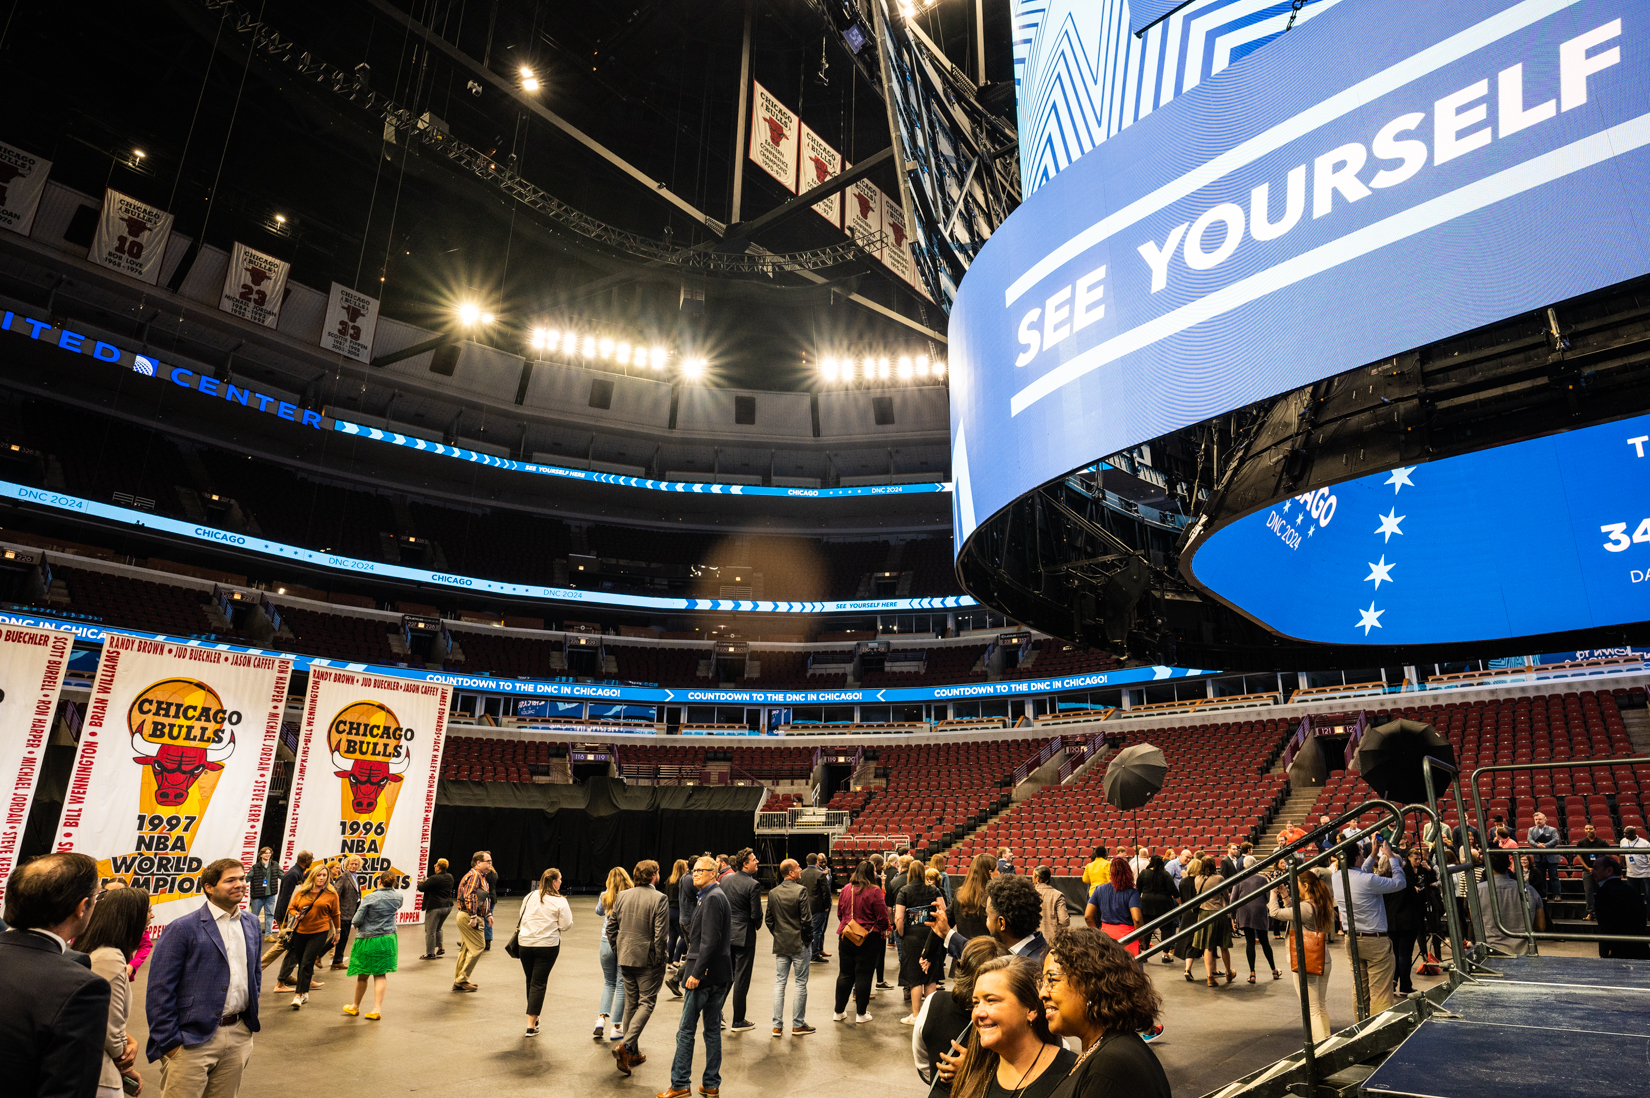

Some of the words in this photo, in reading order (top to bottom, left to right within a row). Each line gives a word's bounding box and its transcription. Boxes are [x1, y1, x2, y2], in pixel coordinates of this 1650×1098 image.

[760, 92, 792, 124] CHICAGO
[765, 104, 788, 128] BULLS
[760, 143, 788, 168] CONFERENCE
[765, 140, 784, 158] EASTERN
[806, 132, 836, 161] CHICAGO
[811, 144, 831, 166] BULLS
[760, 150, 787, 175] CHAMPIONS
[1015, 265, 1106, 367] SEE
[1137, 17, 1622, 294] YOURSELF
[120, 200, 160, 219] CHICAGO
[124, 208, 152, 223] BULLS
[115, 235, 143, 259] 10
[108, 251, 122, 260] BOB
[126, 258, 143, 268] LOVE
[244, 251, 278, 268] CHICAGO
[248, 259, 272, 272] BULLS
[225, 294, 249, 307] MICHAEL
[253, 305, 276, 317] JORDAN
[239, 284, 267, 306] 23
[341, 290, 370, 305] CHICAGO
[345, 298, 365, 309] BULLS
[328, 332, 347, 342] SCOTTIE
[350, 340, 368, 350] PIPPEN
[338, 320, 361, 341] 33
[1, 310, 121, 363] ITED
[170, 367, 322, 430] CENTER
[539, 466, 569, 477] YOURSELF
[1294, 486, 1337, 527] AGO
[1266, 510, 1286, 536] DNC
[1281, 525, 1302, 551] 2024
[18, 488, 48, 501] DNC
[51, 496, 82, 508] 2024
[194, 528, 246, 545] CHICAGO
[328, 557, 349, 568] DNC
[350, 561, 375, 572] 2024
[432, 574, 473, 586] CHICAGO
[544, 589, 561, 597] DNC
[562, 591, 583, 599] 2024
[4, 630, 50, 646] BUECHLER
[50, 636, 68, 658] SCOTT
[109, 636, 136, 651] RANDY
[138, 640, 165, 655] BROWN
[174, 646, 187, 658] JUD
[189, 649, 221, 664] BUECHLER
[231, 654, 252, 668] JASON
[253, 657, 275, 670] CAFFEY
[41, 660, 62, 691] BURRELL
[97, 649, 121, 694] WILLIAMS
[277, 660, 290, 674] RON
[271, 677, 287, 703] HARPER
[313, 669, 332, 682] RANDY
[334, 672, 355, 685] BROWN
[361, 677, 371, 687] JUD
[373, 679, 399, 691] BUECHLER
[403, 683, 419, 694] JASON
[421, 685, 439, 696] CAFFEY
[426, 674, 496, 689] COUNTDOWN
[499, 682, 513, 691] TO
[515, 683, 535, 692] THE
[537, 684, 558, 694] DNC
[561, 686, 571, 694] IN
[574, 687, 620, 697] CHICAGO!
[934, 686, 994, 697] COUNTDOWN
[996, 684, 1008, 693] TO
[1010, 683, 1029, 692] THE
[1031, 681, 1050, 691] DNC
[1053, 680, 1062, 689] IN
[1064, 675, 1108, 688] CHICAGO!
[35, 700, 52, 716] RON
[306, 680, 320, 727] WENNINGTON
[439, 688, 448, 707] JAMES
[688, 692, 750, 701] COUNTDOWN
[752, 693, 764, 701] TO
[766, 693, 784, 702] THE
[786, 694, 805, 702] DNC
[819, 692, 862, 701] CHICAGO!
[89, 698, 109, 727] BRIAN
[138, 698, 242, 725] CHICAGO
[435, 708, 445, 735] EDWARDS
[26, 718, 47, 748] HARPER
[148, 721, 225, 744] BULLS
[264, 712, 280, 742] MICHAEL
[304, 729, 313, 743] BILL
[335, 720, 415, 741] CHICAGO
[344, 739, 402, 758] BULLS
[433, 738, 442, 753] JACK
[257, 744, 274, 771] JORDAN
[298, 746, 310, 781] SIMPKINS
[430, 754, 439, 773] HALEY
[15, 756, 37, 790] MICHAEL
[68, 741, 99, 804] WENNINGTON
[427, 776, 436, 788] RON
[252, 780, 267, 801] STEVE
[424, 790, 434, 813] HARPER
[6, 793, 28, 824] JORDAN
[63, 808, 82, 828] BILL
[247, 804, 262, 822] KERR
[137, 814, 197, 832] 1997
[340, 821, 385, 836] 1996
[421, 817, 430, 843] MICHAEL
[0, 832, 17, 854] STEVE
[135, 835, 186, 852] NBA
[243, 831, 258, 848] TONI
[285, 840, 295, 860] JOHN
[340, 839, 379, 853] NBA
[111, 856, 202, 874] WORLD
[418, 846, 428, 870] JORDAN
[414, 894, 423, 911] KERR
[400, 912, 420, 923] PIPPEN
